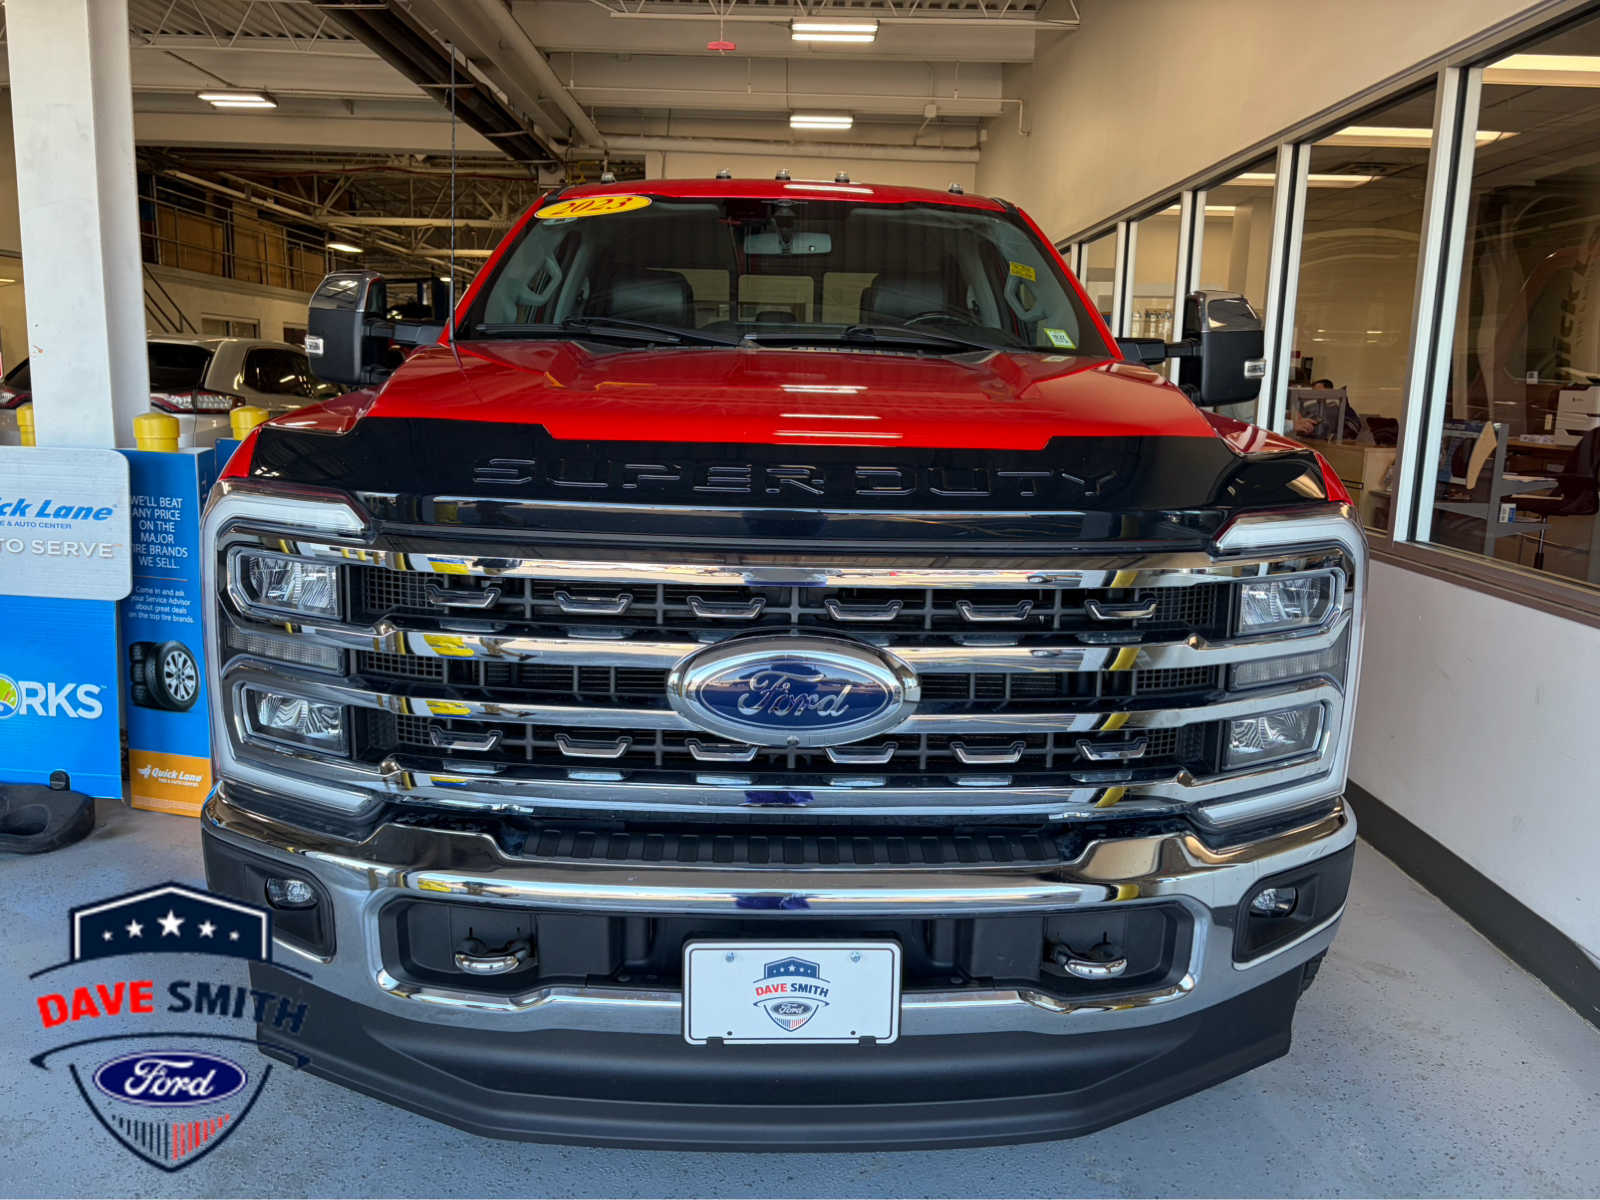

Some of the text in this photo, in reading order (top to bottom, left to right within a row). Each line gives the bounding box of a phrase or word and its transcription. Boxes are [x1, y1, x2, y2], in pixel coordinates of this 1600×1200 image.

[551, 197, 634, 215] 2023
[472, 457, 1119, 497] SUPER DUTY
[0, 498, 113, 521] ck Lane
[160, 497, 183, 509] BEAT
[132, 507, 181, 521] ANY PRICE
[15, 520, 37, 528] AUTO
[39, 521, 72, 529] CENTER
[139, 520, 175, 533] ON THE
[140, 532, 175, 545] MAJOR
[31, 539, 113, 559] SERVE
[132, 544, 189, 558] IRE BRANDS
[138, 556, 154, 568] WE
[737, 669, 853, 717] Ford
[152, 768, 178, 779] Quick
[179, 771, 202, 782] Lane
[755, 983, 829, 997] DAVE SMITH
